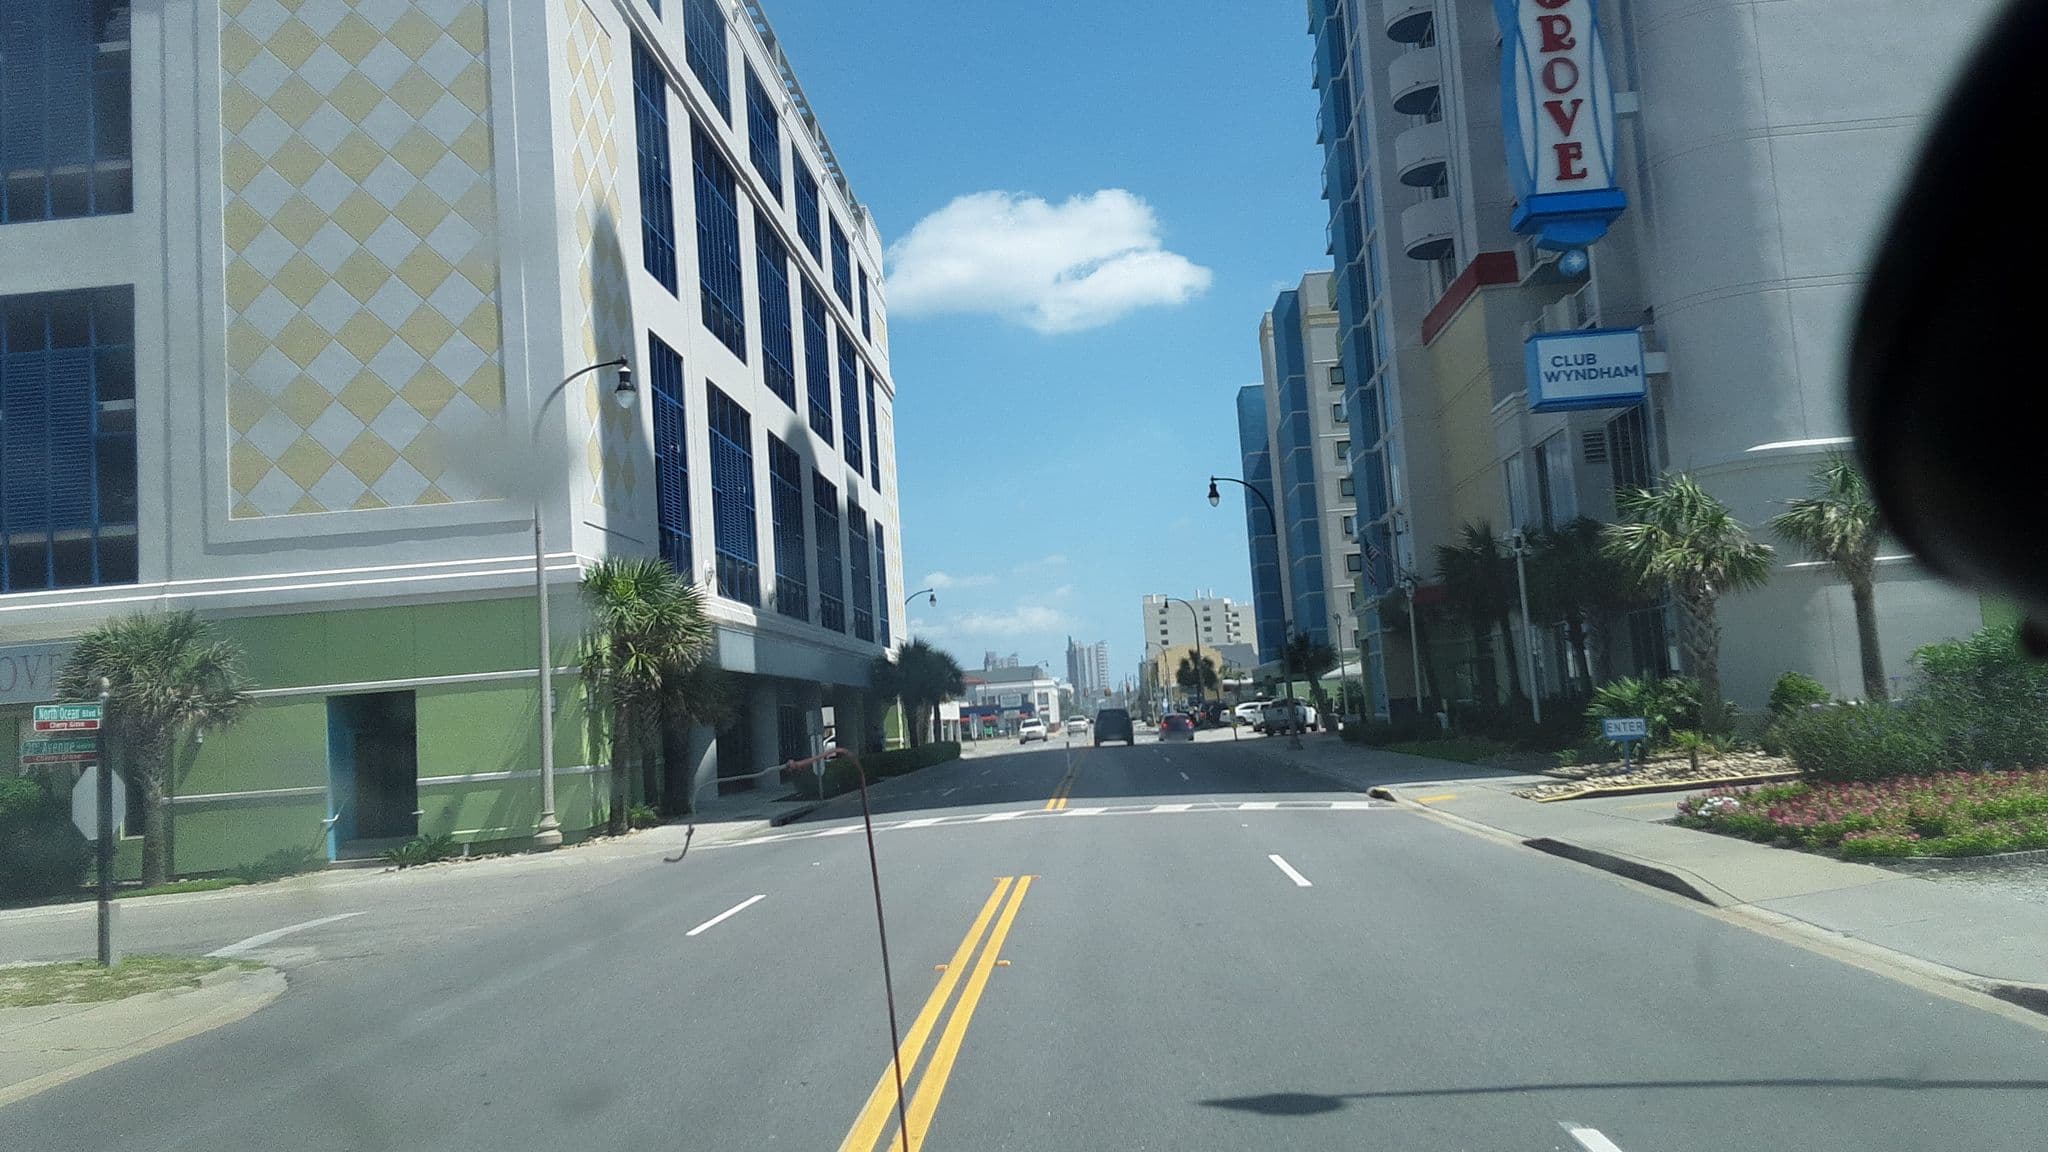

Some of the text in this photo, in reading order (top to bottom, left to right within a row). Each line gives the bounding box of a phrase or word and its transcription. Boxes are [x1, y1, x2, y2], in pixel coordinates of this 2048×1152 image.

[1535, 0, 1588, 181] ROVE
[1551, 353, 1597, 368] CLUB
[1544, 364, 1639, 383] WYNDHAM
[38, 707, 96, 720] North Ocean Blvd
[1606, 721, 1643, 733] ENTER
